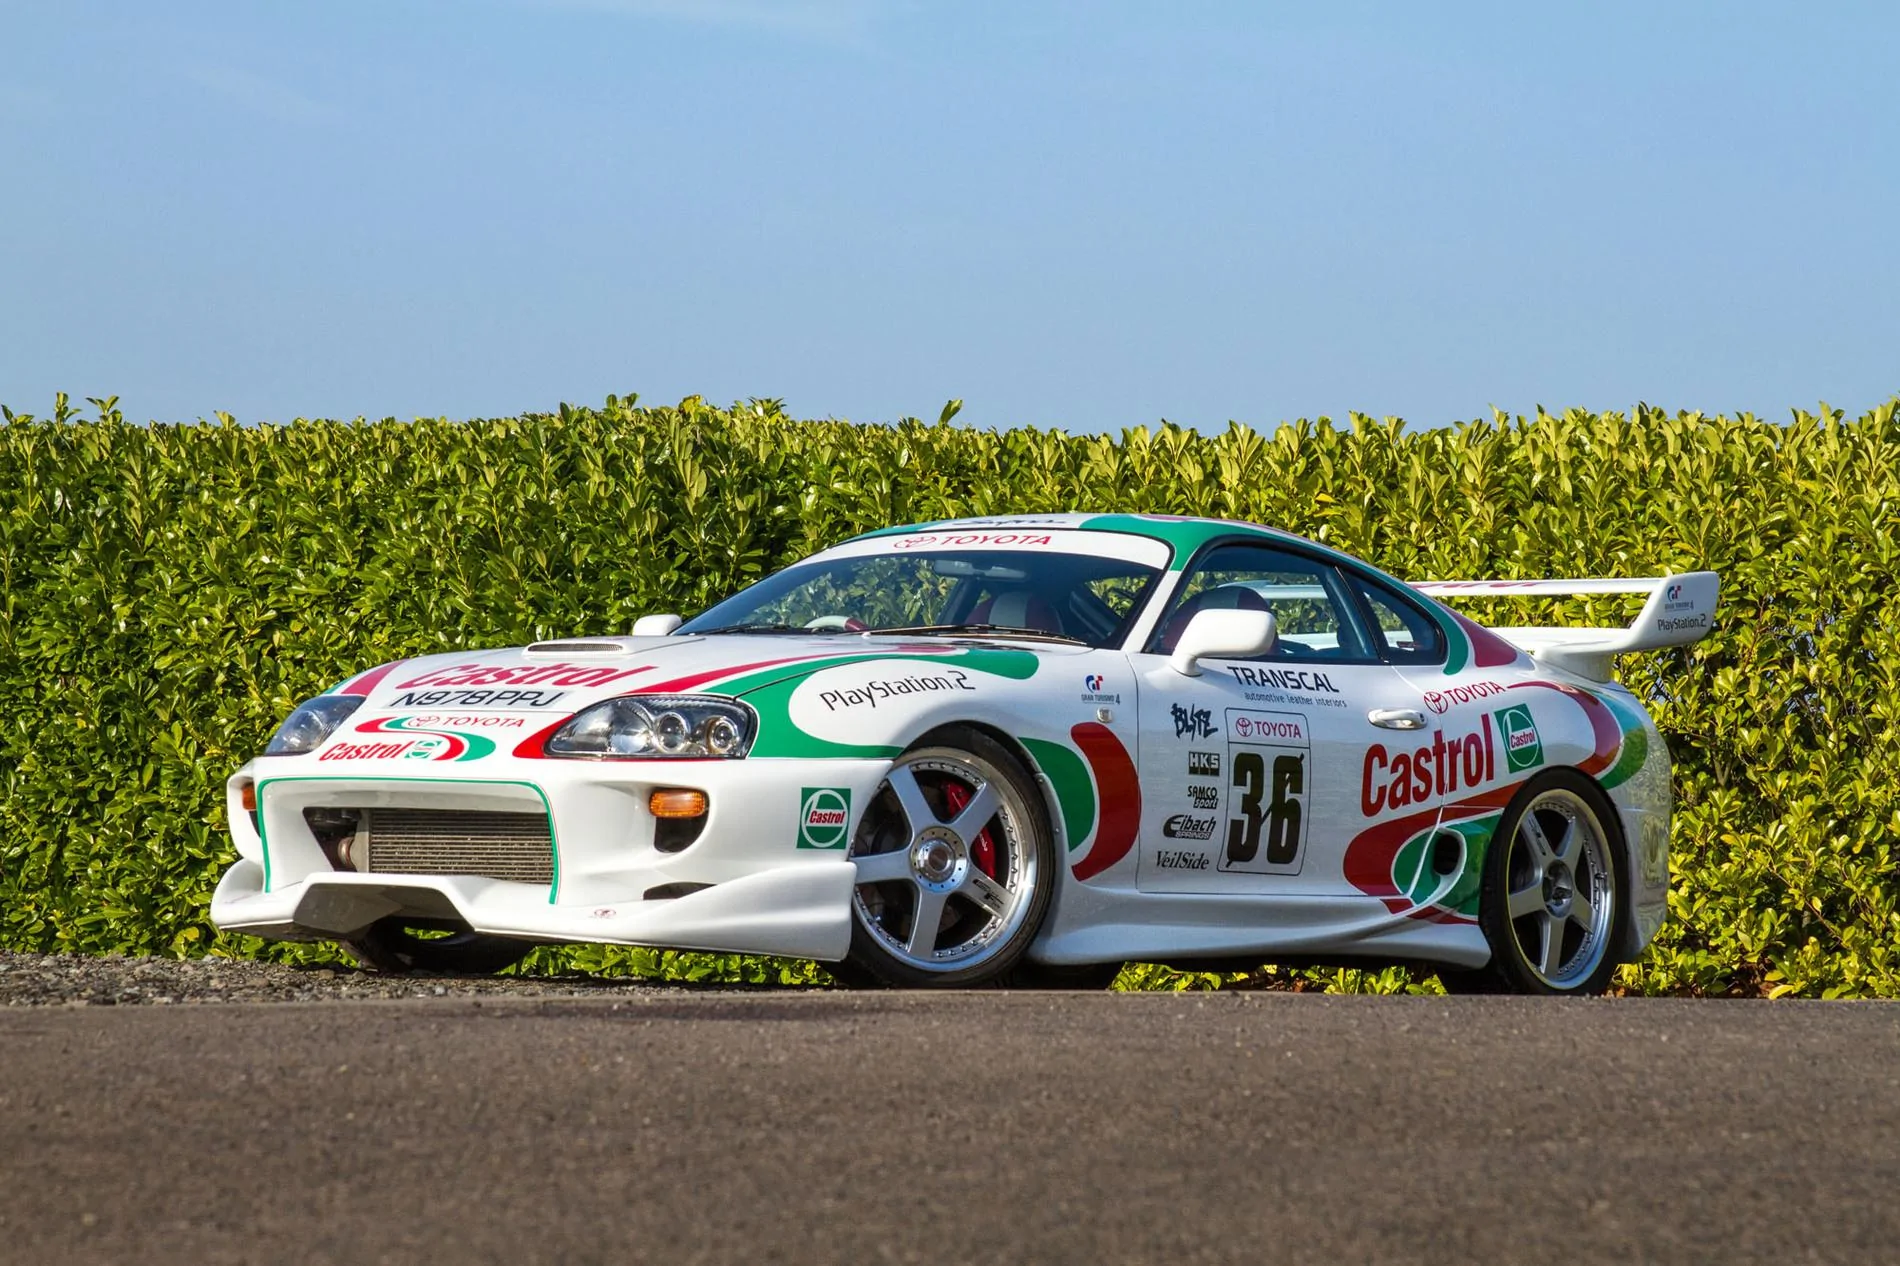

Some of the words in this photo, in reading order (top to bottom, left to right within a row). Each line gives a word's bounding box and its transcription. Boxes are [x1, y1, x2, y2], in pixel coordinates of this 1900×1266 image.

[940, 534, 1052, 546] TOYOTA
[394, 662, 658, 689] Castrol
[1227, 666, 1340, 693] TRANSCAL
[390, 690, 567, 707] N978PPJ
[819, 674, 954, 711] PlayStation
[1244, 692, 1285, 704] automotive
[1287, 695, 1313, 705] leather
[1315, 697, 1347, 708] interiors
[1444, 681, 1506, 705] TOYOTA
[443, 715, 525, 728] TOYOTA
[1254, 721, 1302, 738] TOYOTA
[1510, 728, 1536, 749] Castrol
[318, 740, 415, 761] Castrol
[1189, 752, 1219, 769] HKS
[1361, 713, 1494, 818] Castrol
[1187, 785, 1218, 800] SAMCO
[809, 808, 845, 825] Castrol
[1227, 752, 1304, 865] 36
[1163, 814, 1216, 838] Eibach
[1175, 830, 1211, 840] SPRINGS
[1156, 850, 1209, 870] VeilSide
